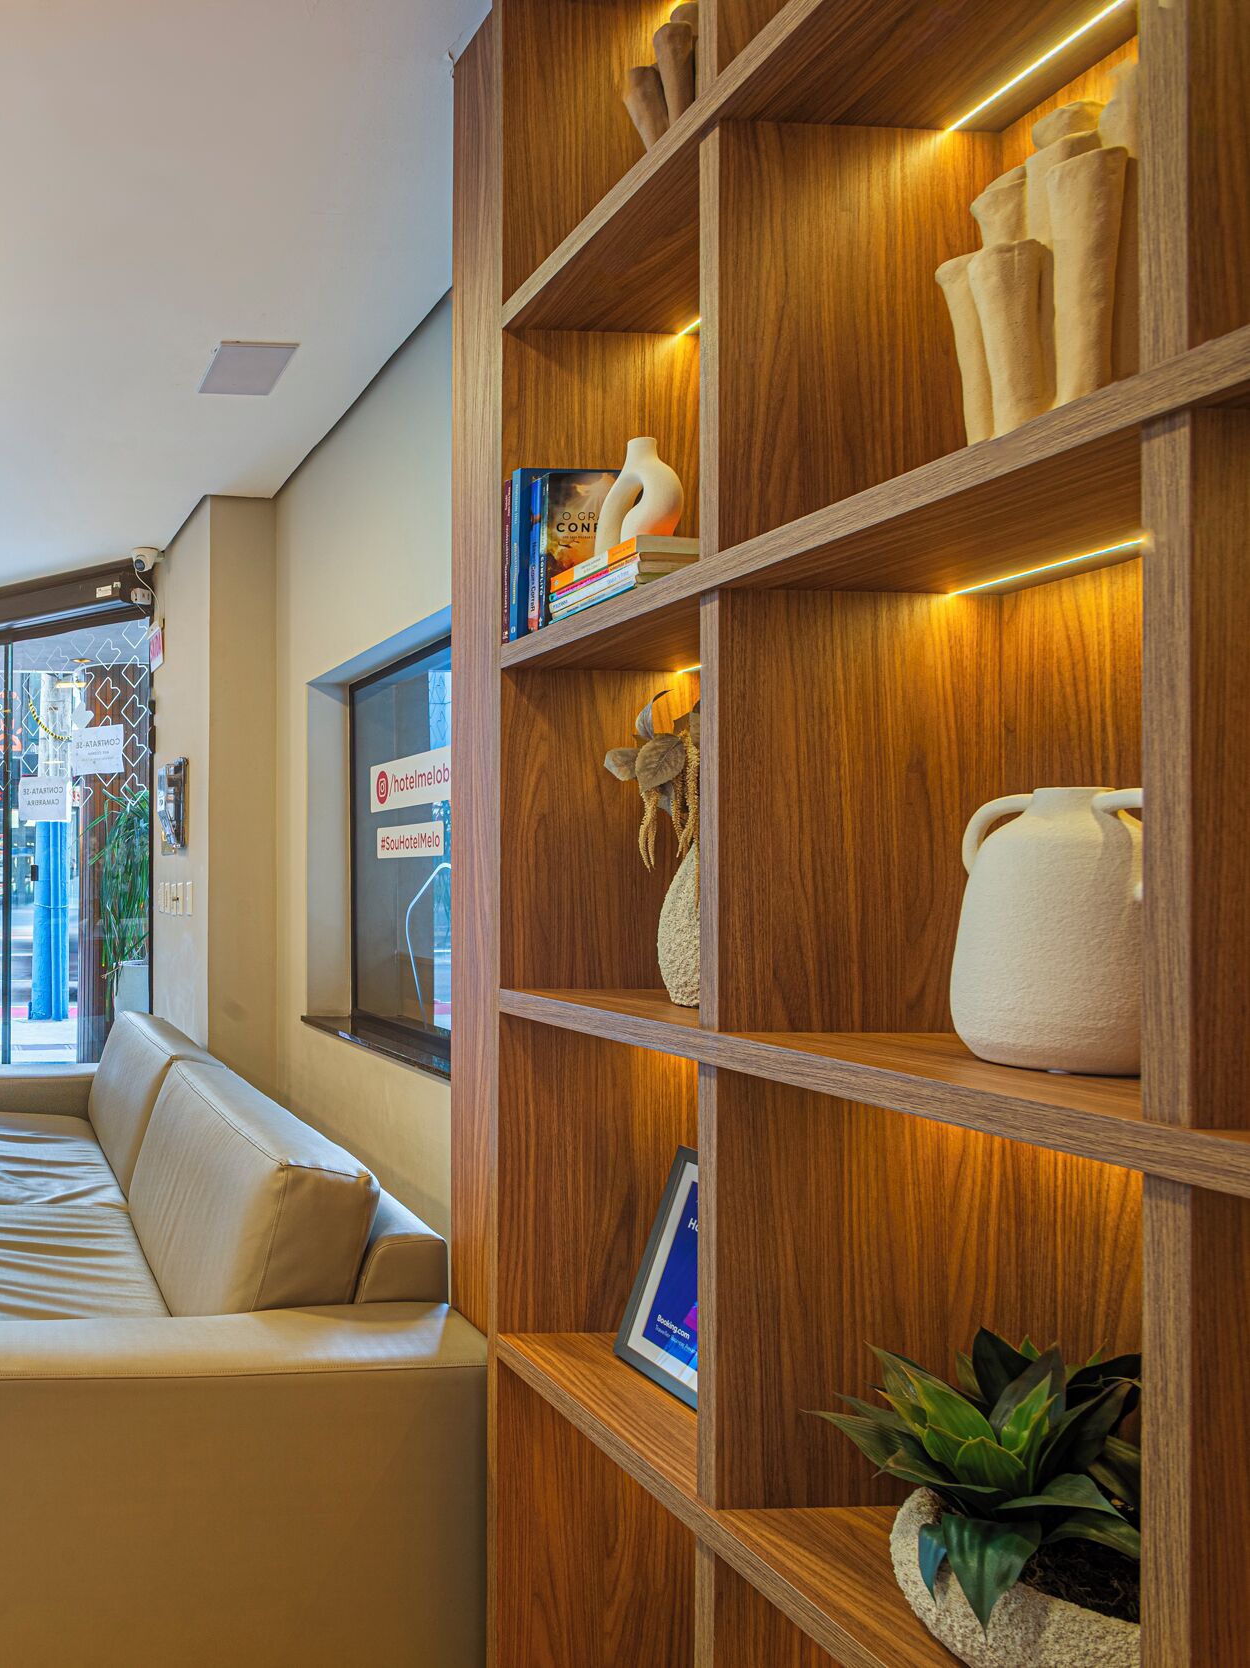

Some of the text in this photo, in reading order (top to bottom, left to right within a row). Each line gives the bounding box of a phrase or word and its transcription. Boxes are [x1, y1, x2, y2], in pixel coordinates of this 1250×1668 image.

[562, 512, 599, 521] O GR
[380, 832, 441, 851] #SouHotelMelo
[656, 1314, 690, 1340] Booking.com
